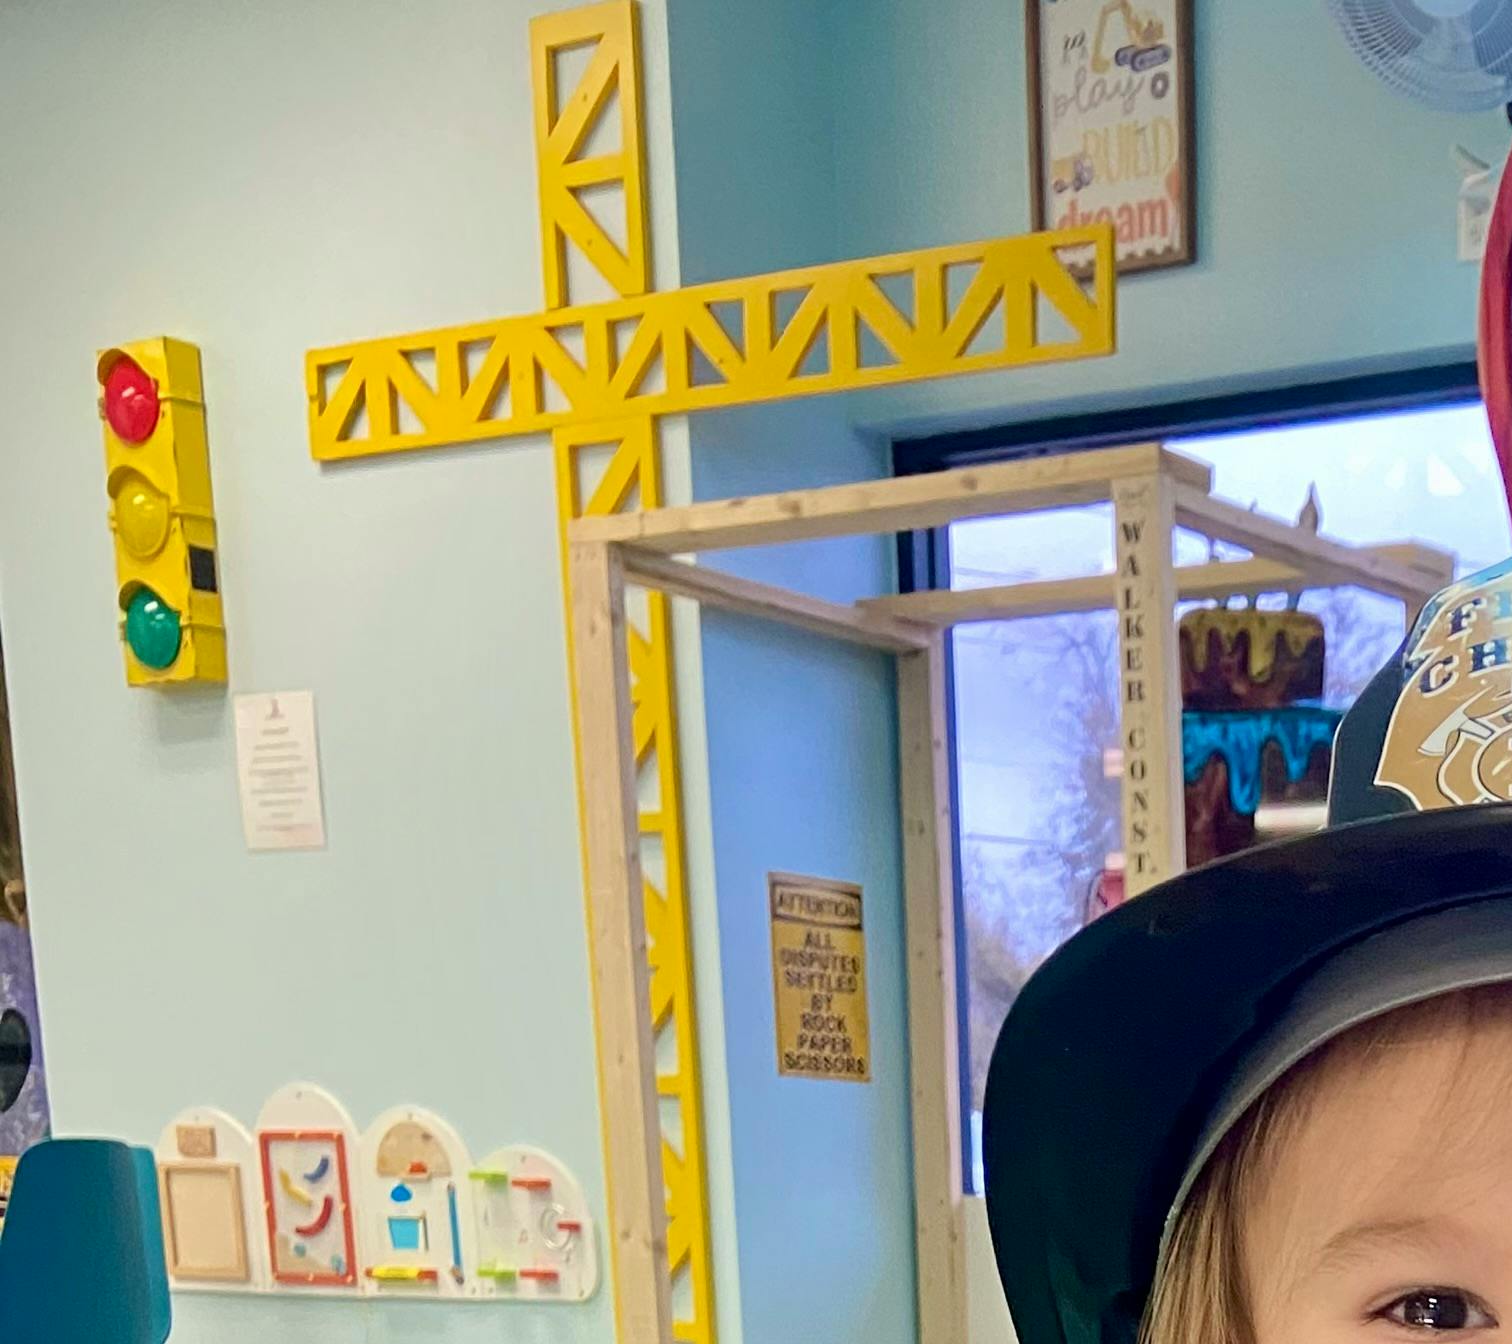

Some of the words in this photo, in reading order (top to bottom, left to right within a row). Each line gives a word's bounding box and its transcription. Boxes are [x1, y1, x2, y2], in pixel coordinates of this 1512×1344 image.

[1054, 66, 1145, 119] play
[1120, 519, 1147, 702] WALKER
[804, 929, 836, 949] ALL
[780, 948, 860, 976] DISPUTES
[784, 967, 858, 994] SETTLED
[811, 993, 833, 1013] BY
[801, 1013, 847, 1033] ROCK
[797, 1033, 852, 1054] PAPER
[784, 1052, 866, 1075] SCISSORS
